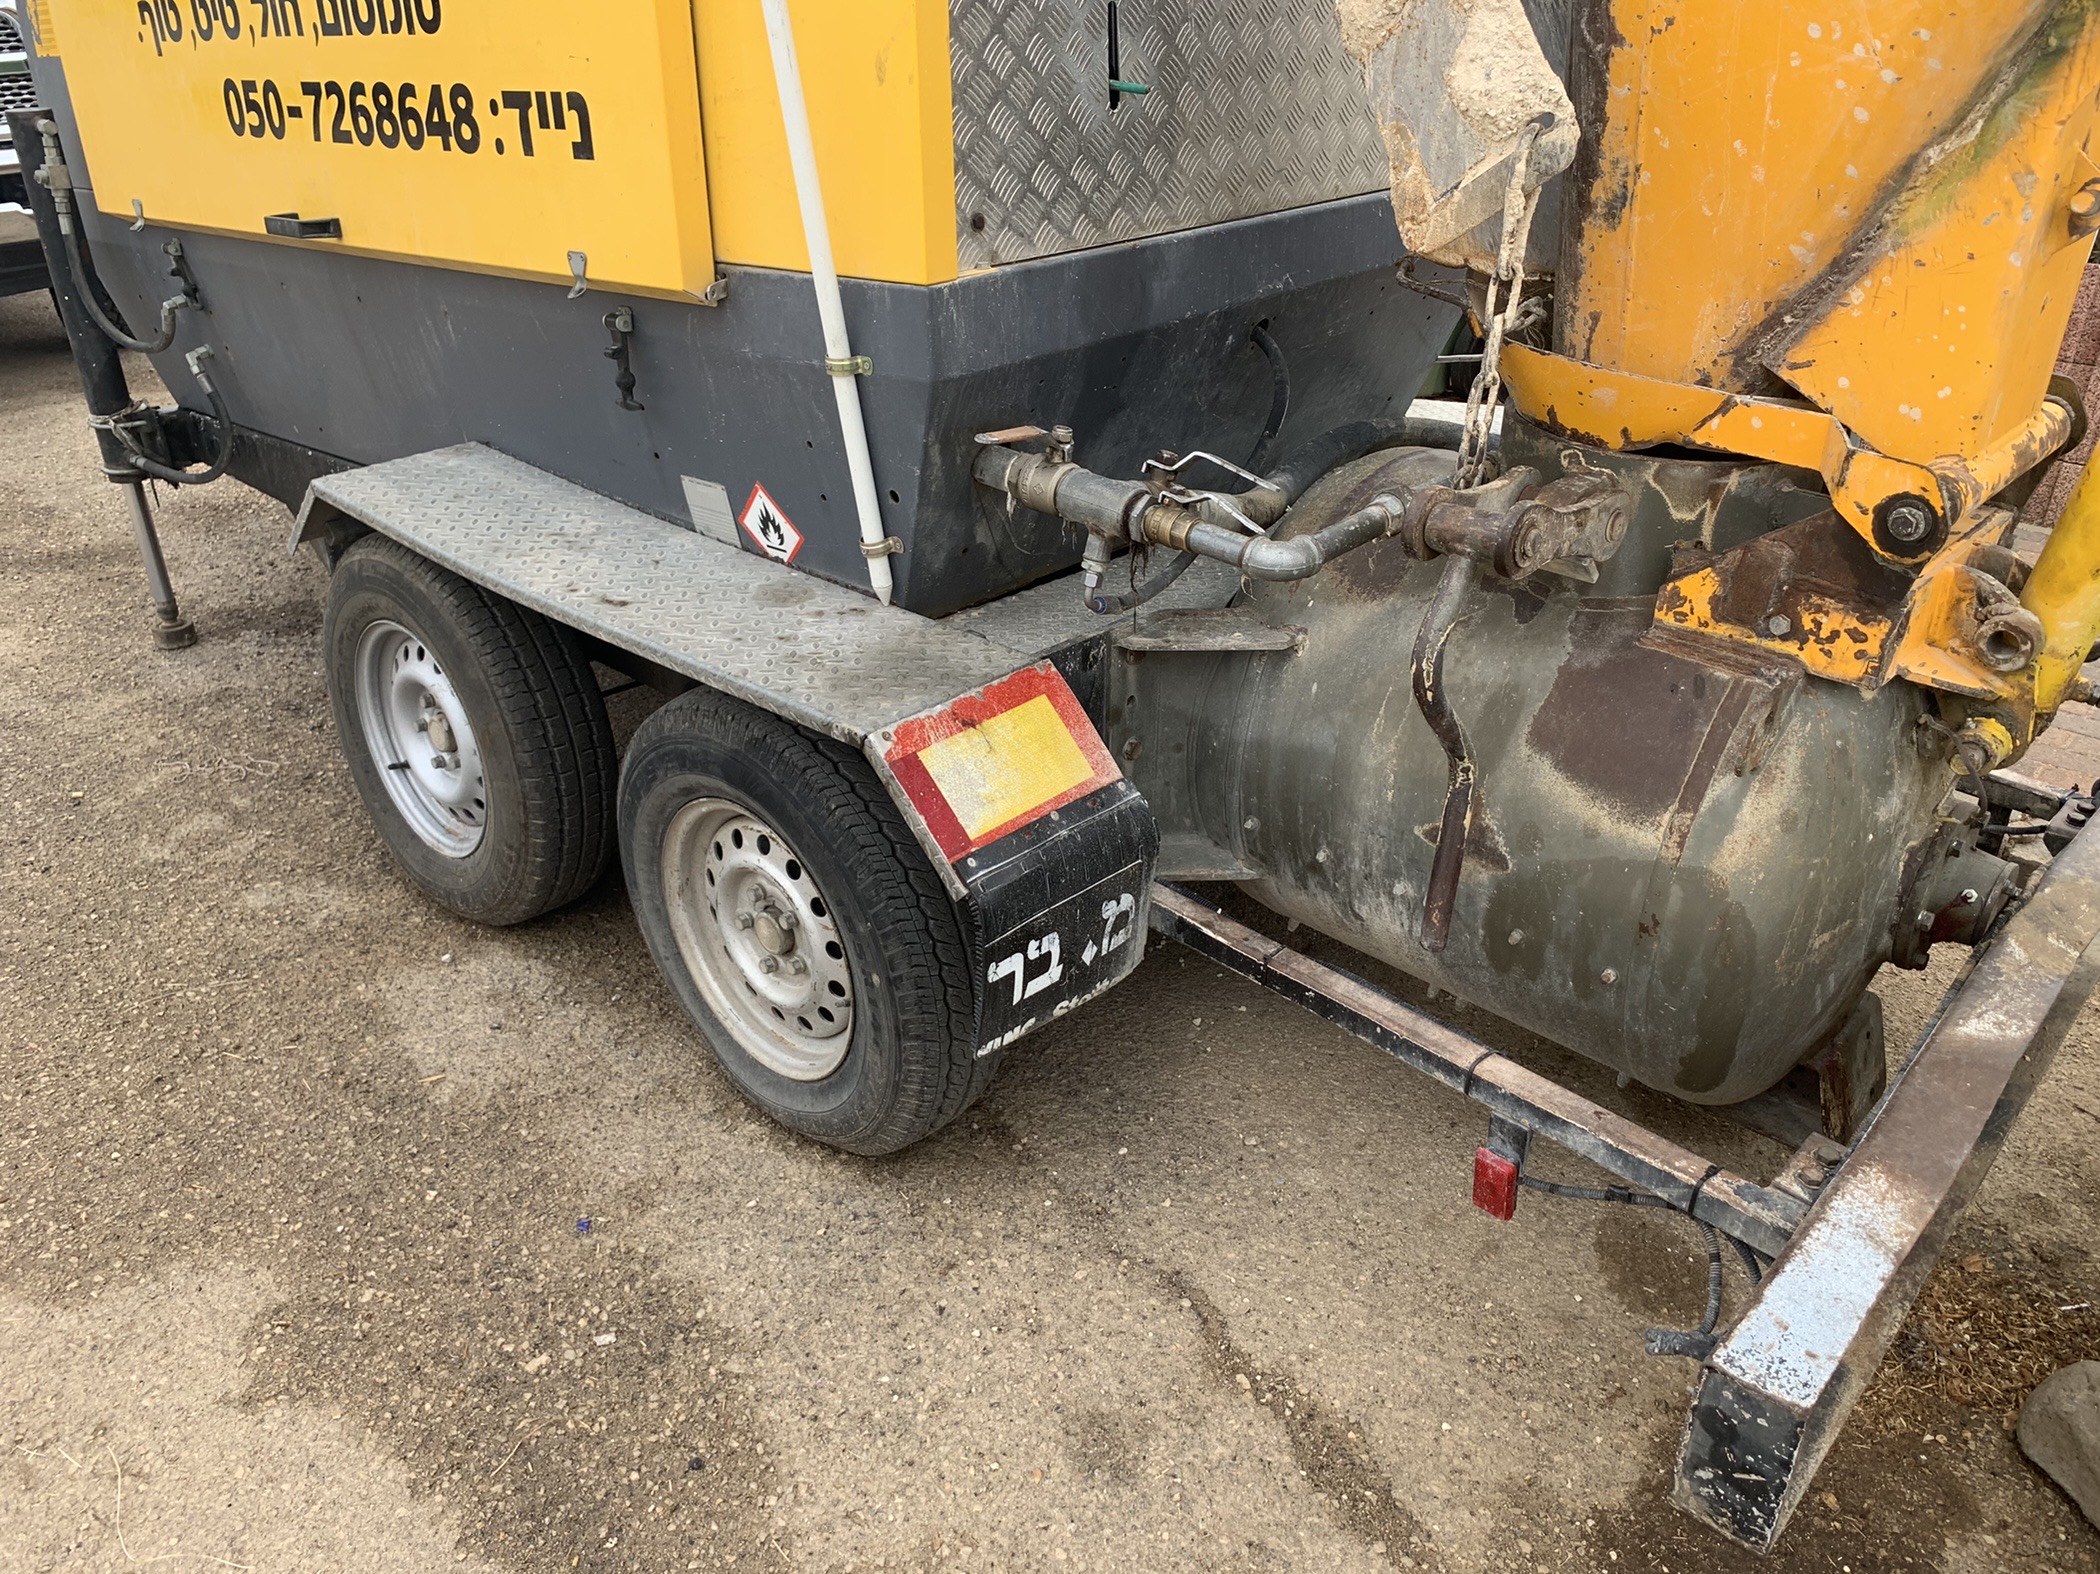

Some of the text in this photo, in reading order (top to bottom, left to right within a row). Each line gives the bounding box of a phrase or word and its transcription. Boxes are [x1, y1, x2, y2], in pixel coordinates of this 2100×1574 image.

[137, 0, 183, 57] טוף.
[223, 77, 595, 161] נייד: 050-7268648
